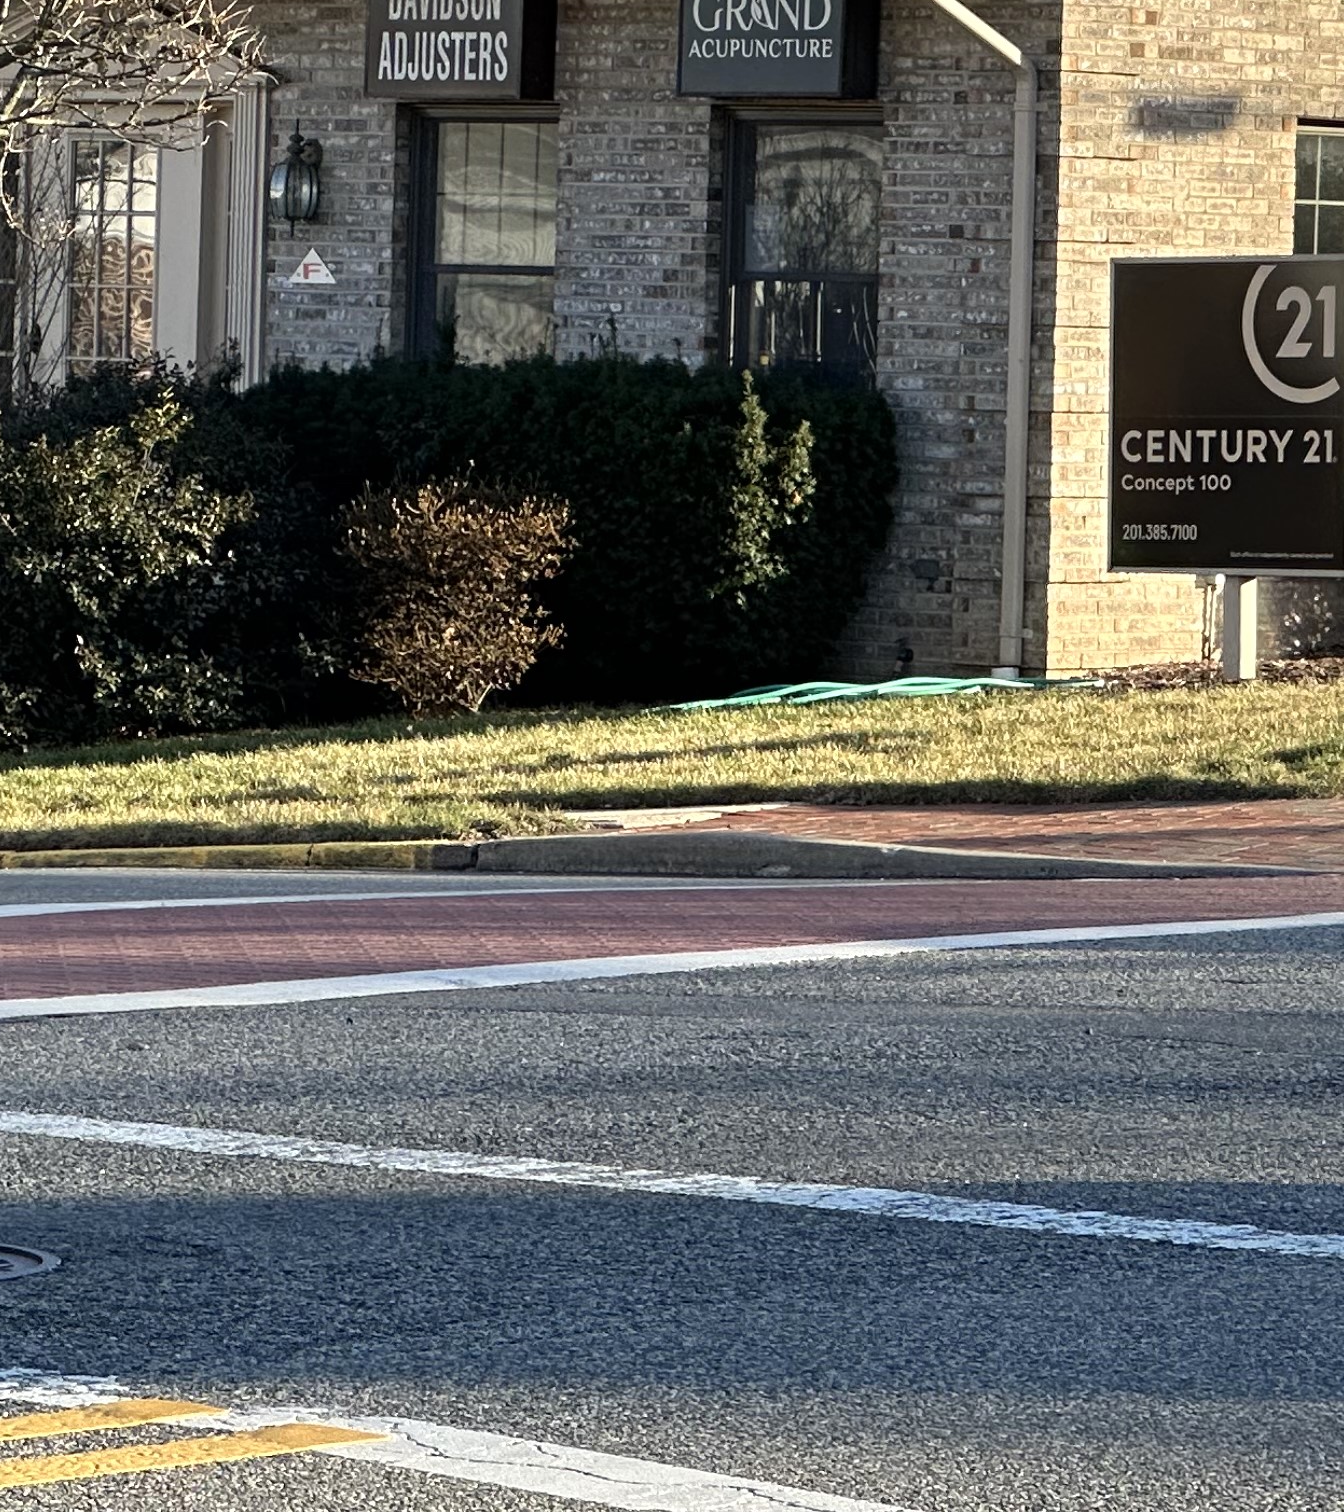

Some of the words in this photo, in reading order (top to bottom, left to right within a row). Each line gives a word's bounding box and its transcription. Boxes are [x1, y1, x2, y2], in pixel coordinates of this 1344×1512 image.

[377, 31, 509, 83] ADJUSTERS
[688, 37, 834, 61] ACUPUNCTURE
[303, 263, 322, 280] F
[1120, 429, 1294, 464] CENTURY
[1303, 429, 1335, 464] 21
[1121, 474, 1195, 495] Concept
[1199, 474, 1232, 492] 100
[1122, 524, 1198, 541] 201.385.7100
